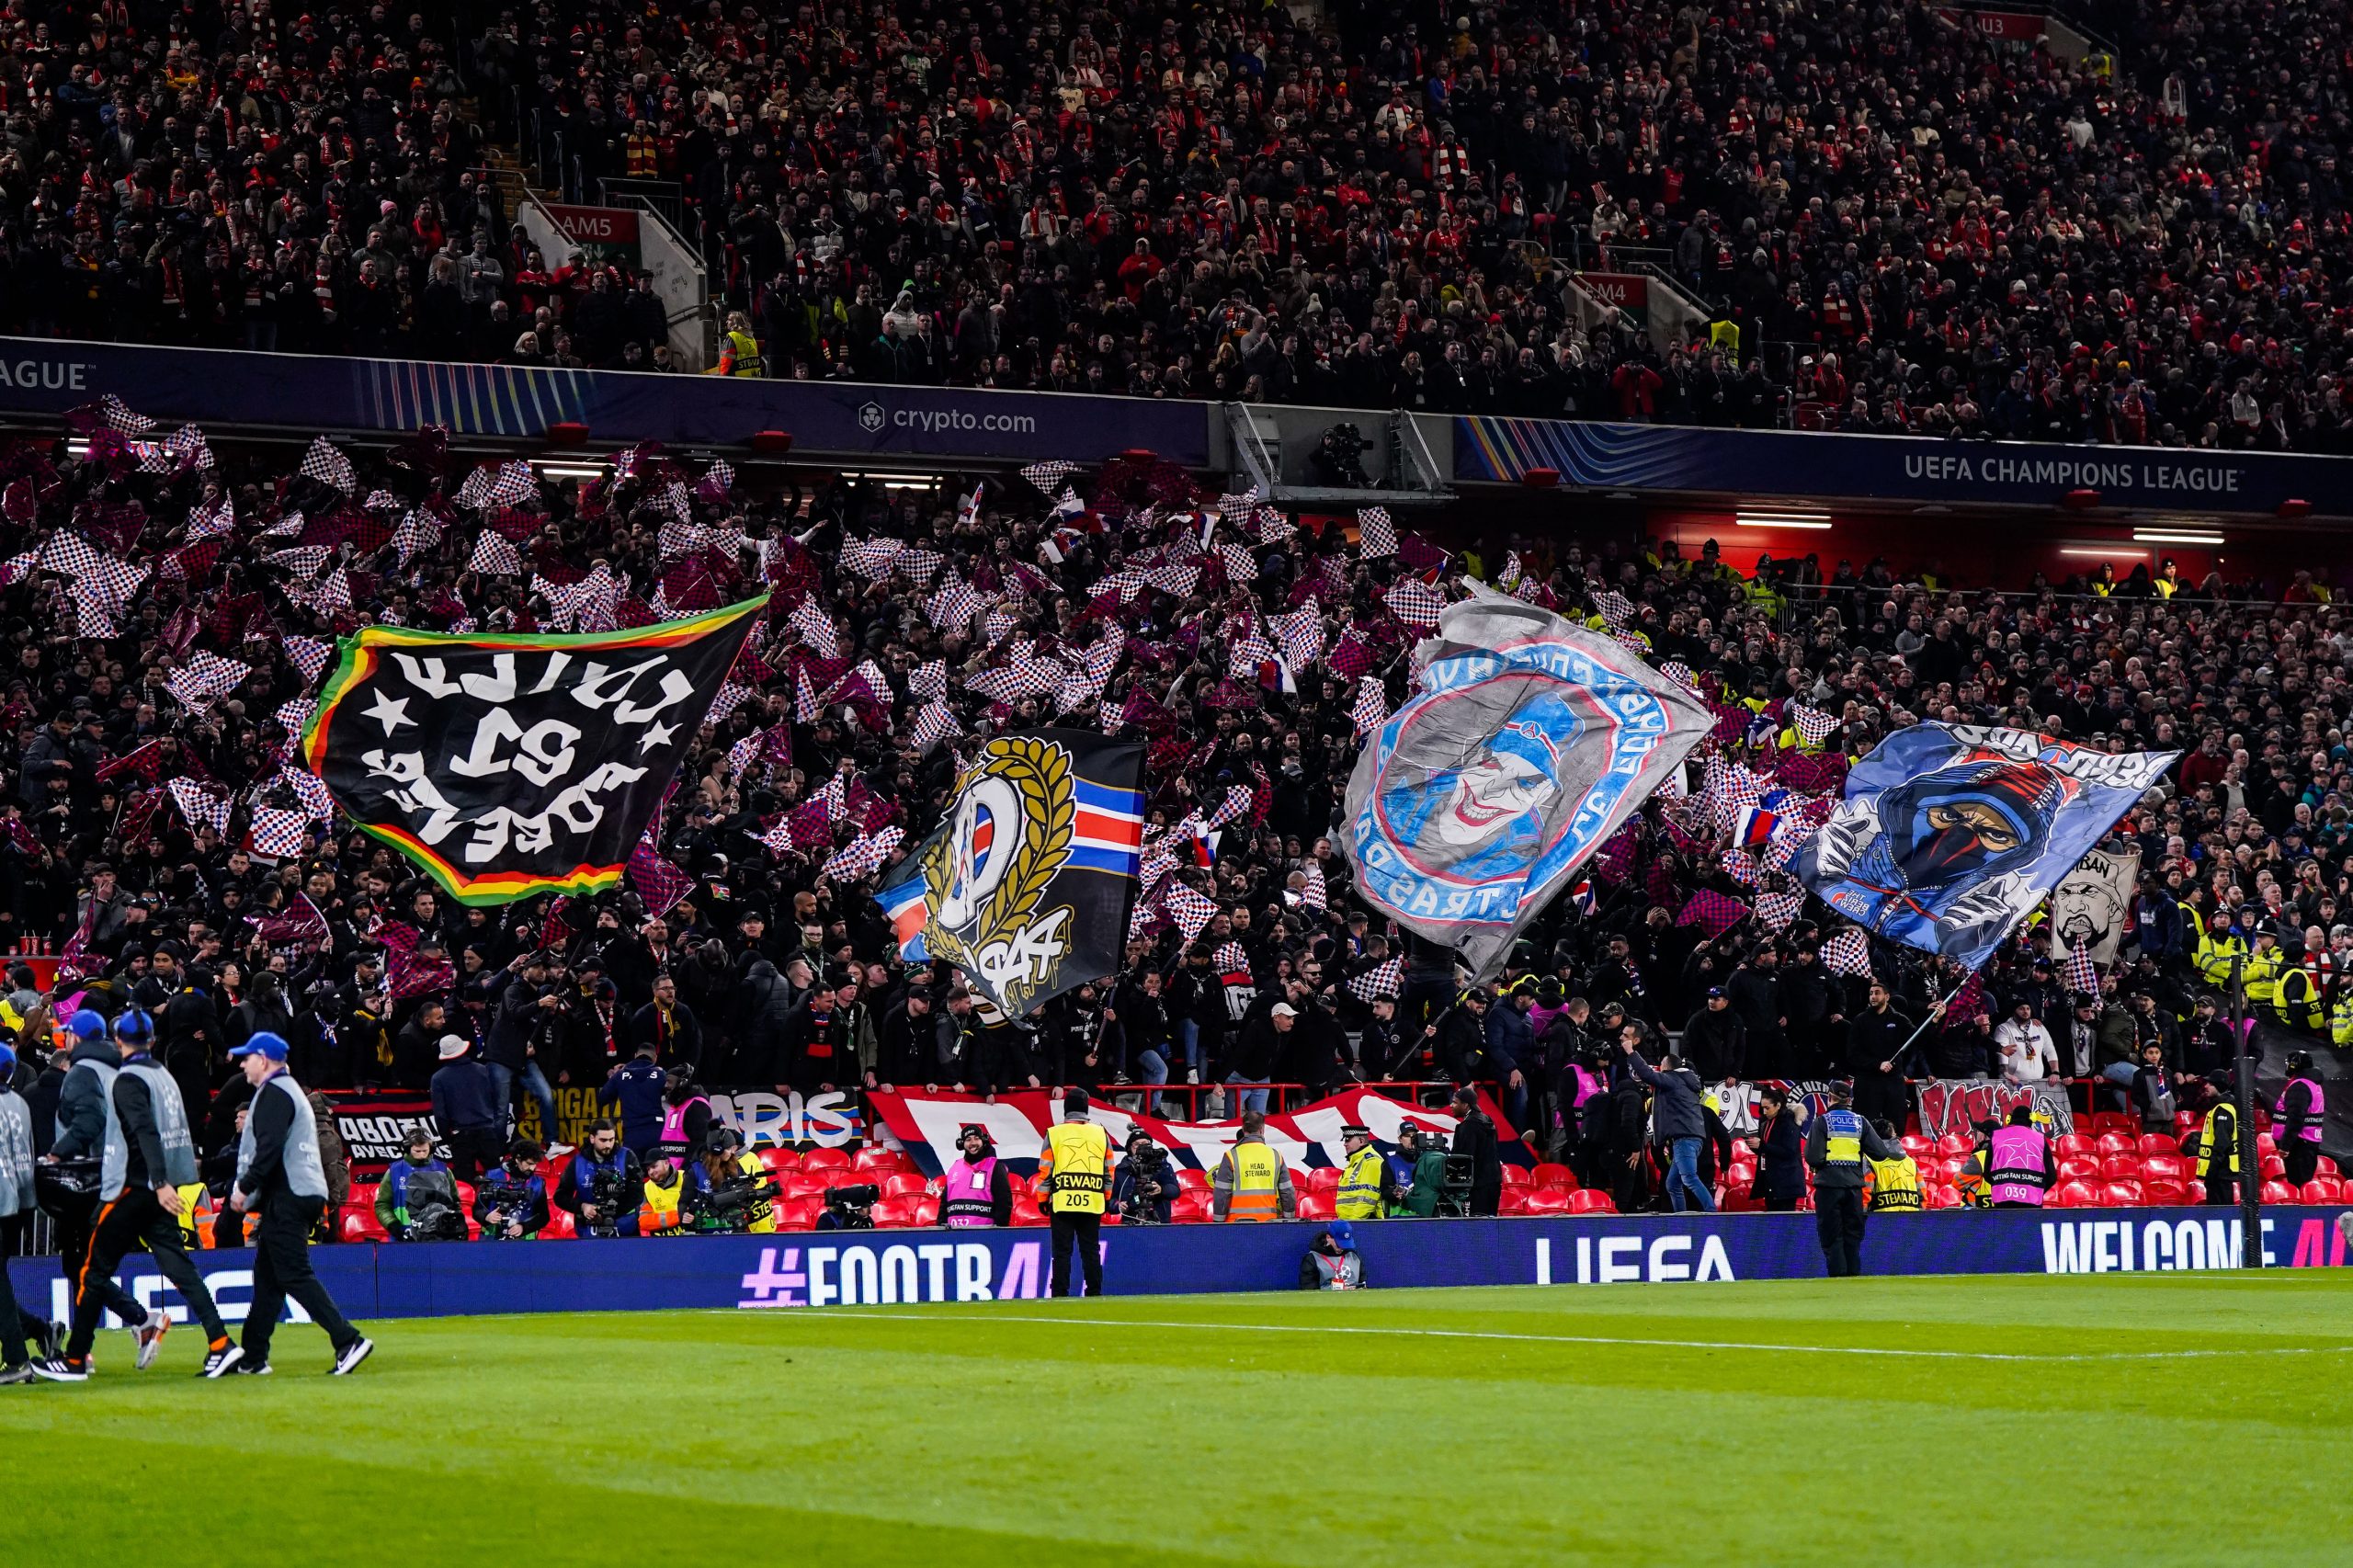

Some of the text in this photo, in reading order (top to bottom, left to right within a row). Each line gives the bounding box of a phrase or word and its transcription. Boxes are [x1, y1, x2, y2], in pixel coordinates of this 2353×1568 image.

[1977, 17, 2004, 34] U3
[563, 215, 612, 237] AM5
[893, 408, 1036, 433] crypto.com
[1904, 454, 2239, 492] UEFA CHAMPIONS LEAGUE
[709, 1090, 853, 1151] ARIS
[351, 1144, 403, 1159] AVEC
[1245, 1169, 1270, 1177] STEWARD
[1055, 1174, 1103, 1190] STEWARD
[1877, 1193, 1919, 1206] STEWARD
[2006, 1186, 2028, 1199] 039
[965, 1204, 992, 1212] SUPPORT
[1066, 1194, 1090, 1207] 205
